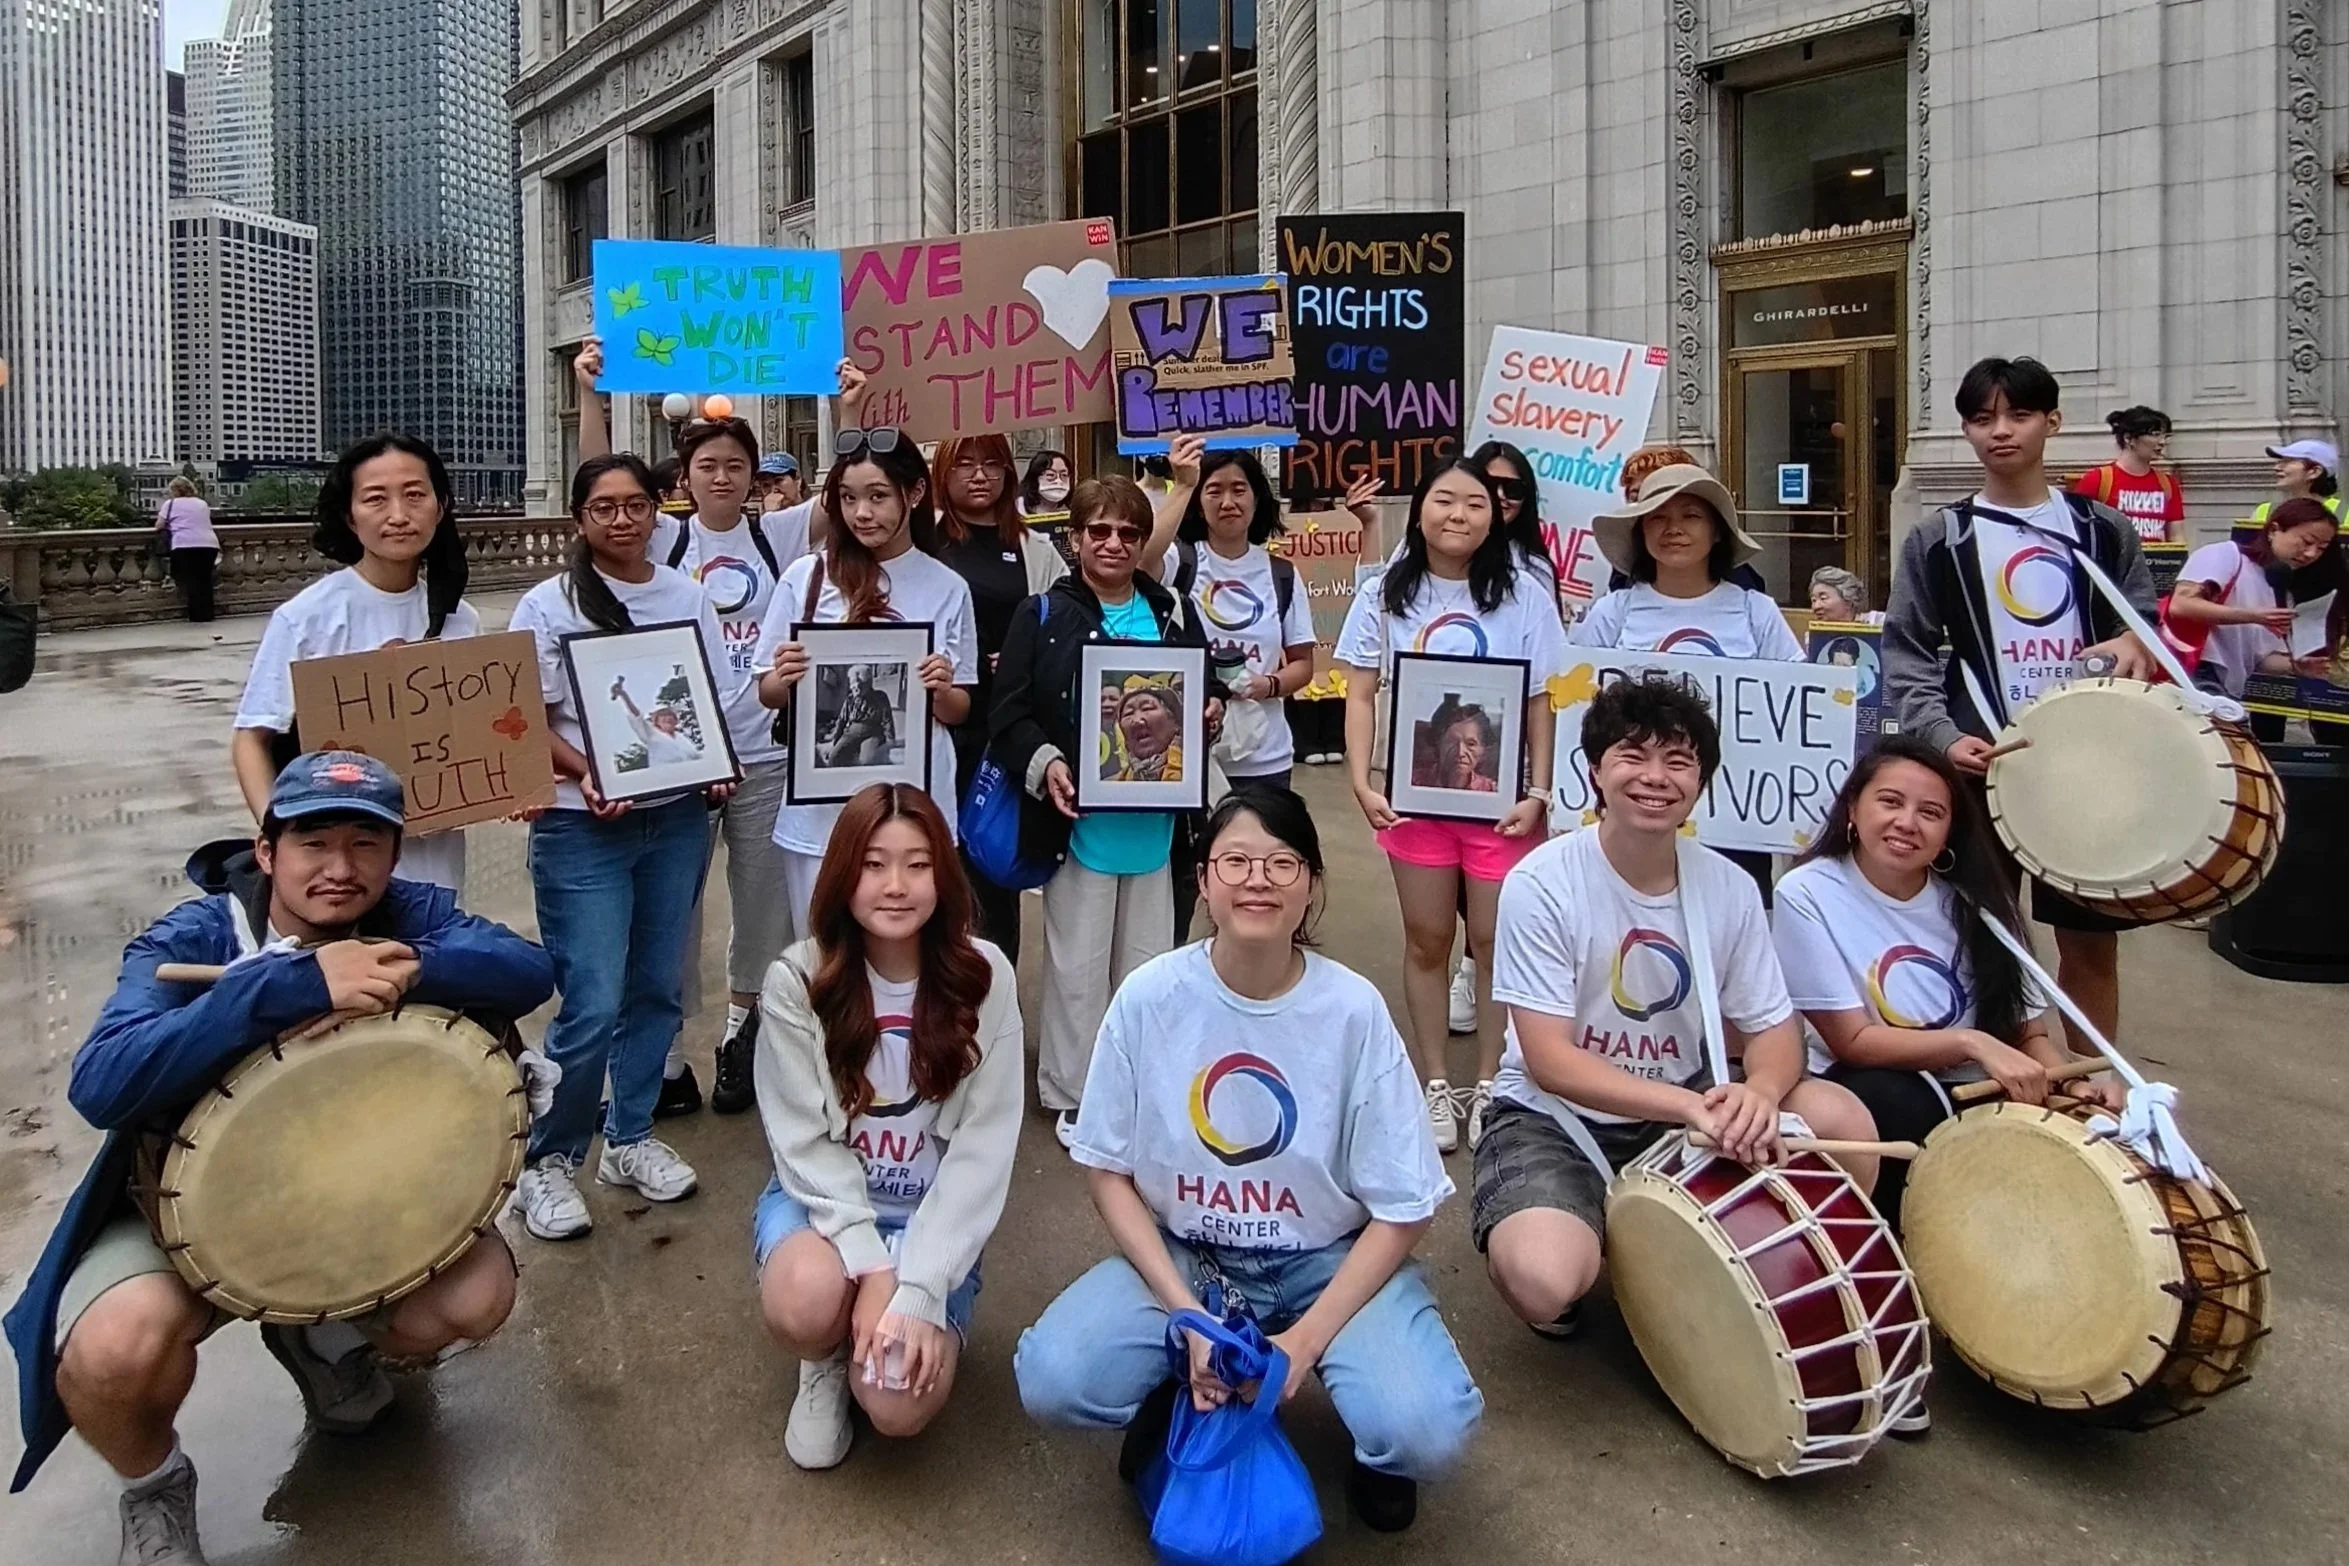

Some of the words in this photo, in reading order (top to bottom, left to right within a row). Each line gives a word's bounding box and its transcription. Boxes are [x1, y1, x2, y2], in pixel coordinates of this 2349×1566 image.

[1088, 225, 1107, 234] KAN
[1089, 234, 1109, 243] WIN
[1284, 227, 1452, 276] WOMEN'S
[652, 265, 814, 303] TRUTH
[842, 242, 962, 312] WE
[1297, 285, 1429, 330] RIGHTS
[1753, 303, 1868, 322] GHIRARDELLI
[679, 308, 819, 350] WON'T
[853, 302, 1040, 374] STAND
[1128, 289, 1283, 366] WE
[708, 351, 786, 385] DIE
[1193, 363, 1223, 373] slather
[1326, 341, 1389, 373] are
[1500, 347, 1632, 397] sexual
[860, 388, 911, 429] ith
[927, 350, 1115, 431] THEM
[1118, 365, 1297, 438] REMEMBER
[1283, 531, 1362, 558] JUSTIC
[723, 620, 761, 641] NA
[411, 734, 450, 764] IS
[405, 752, 514, 817] UTH
[1582, 1024, 1681, 1061] HANA
[1613, 1064, 1664, 1079] NTER
[849, 1129, 926, 1162] ANA
[863, 1164, 911, 1179] NTER
[1177, 1173, 1305, 1219] HANA
[1201, 1215, 1281, 1238] CENTER
